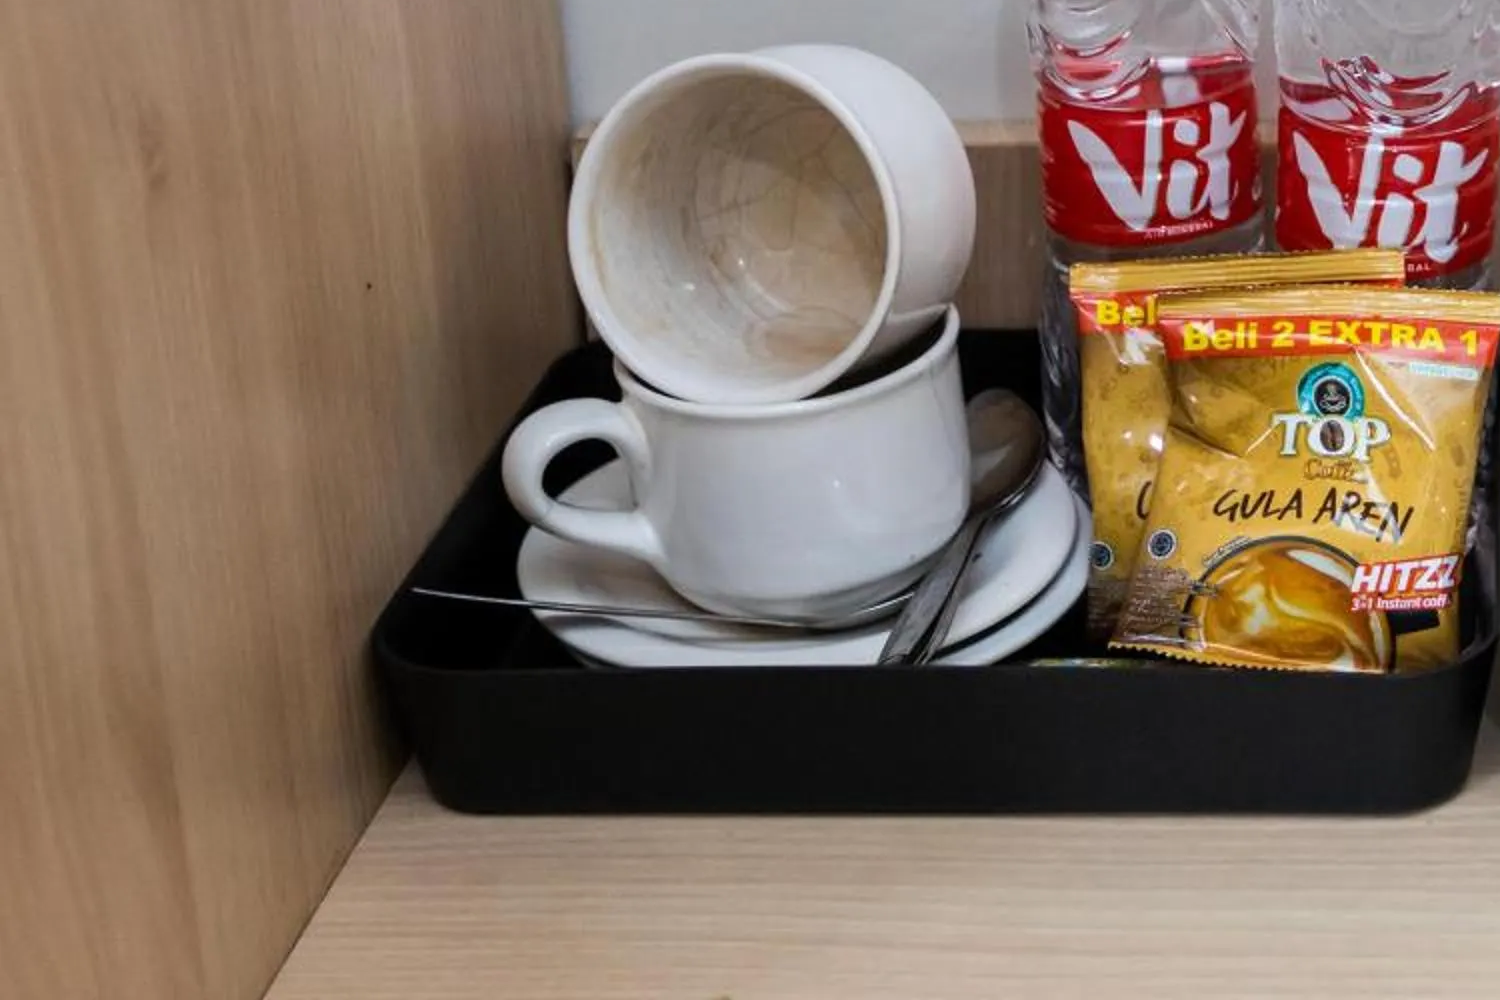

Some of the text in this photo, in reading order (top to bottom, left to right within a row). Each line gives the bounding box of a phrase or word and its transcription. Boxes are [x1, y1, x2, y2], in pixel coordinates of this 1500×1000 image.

[1068, 100, 1245, 232] Vit
[1293, 117, 1489, 263] Vit
[1096, 294, 1158, 327] Bel
[1183, 319, 1480, 356] Beli 2 EXTRA 1
[1271, 412, 1392, 462] TOP
[1213, 486, 1415, 544] GULA AREN
[1351, 555, 1460, 593] HITZZ
